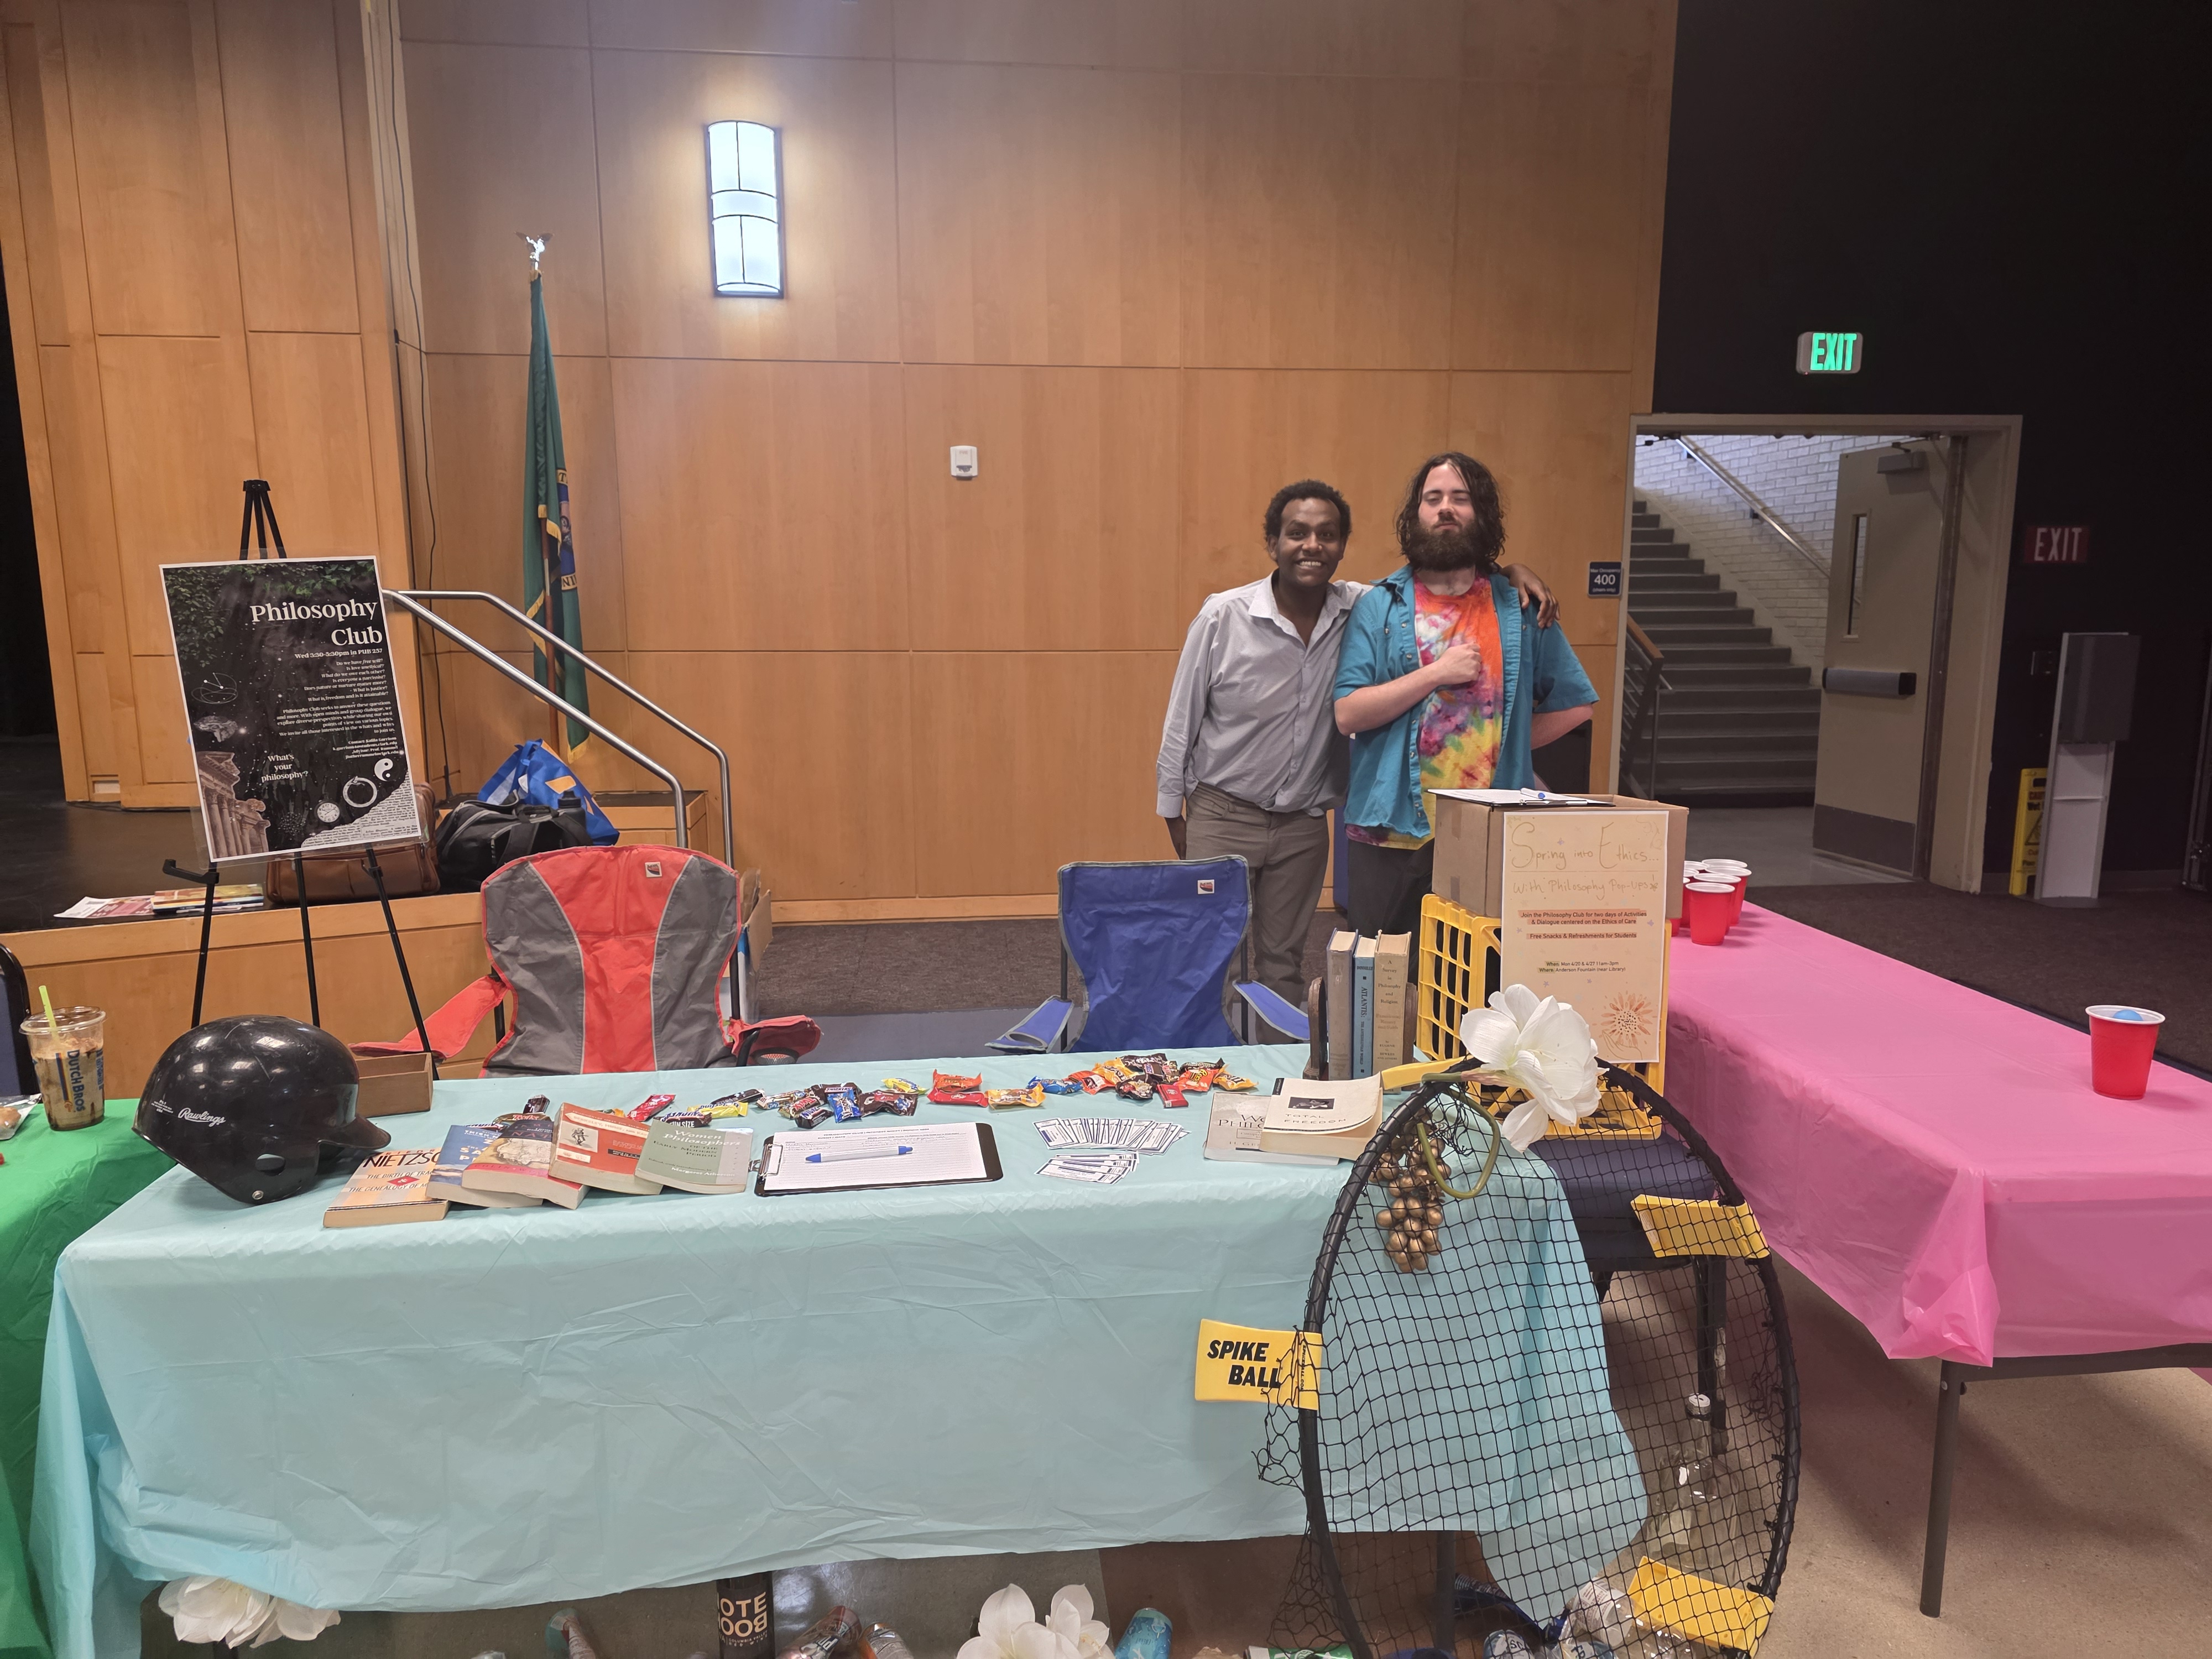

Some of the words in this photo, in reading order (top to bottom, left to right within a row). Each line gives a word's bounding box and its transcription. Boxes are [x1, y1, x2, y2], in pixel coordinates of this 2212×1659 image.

[1810, 333, 1857, 371] EXIT
[2034, 528, 2081, 561] EXIT
[1594, 574, 1615, 585] 400
[250, 599, 378, 622] Philosophy
[331, 626, 383, 646] Club
[261, 771, 308, 783] philosophy?
[274, 764, 293, 773] your
[1511, 822, 1567, 870] Spring
[1513, 879, 1544, 894] With
[1548, 879, 1605, 900] Philosophy
[67, 1050, 84, 1084] DUTCH
[72, 1084, 85, 1112] BROS
[178, 1107, 226, 1127] Rawlings
[654, 1140, 678, 1149] EARLY
[662, 1134, 740, 1146] Philosophers
[675, 1130, 721, 1139] Women
[363, 1151, 441, 1168] NIETZSC
[671, 1167, 702, 1175] Margaret
[1207, 1339, 1270, 1361] SPIKE
[1228, 1365, 1281, 1389] BALL
[717, 1592, 767, 1618] OTE
[750, 1634, 768, 1645] WINE
[754, 1630, 768, 1640] VALLEY
